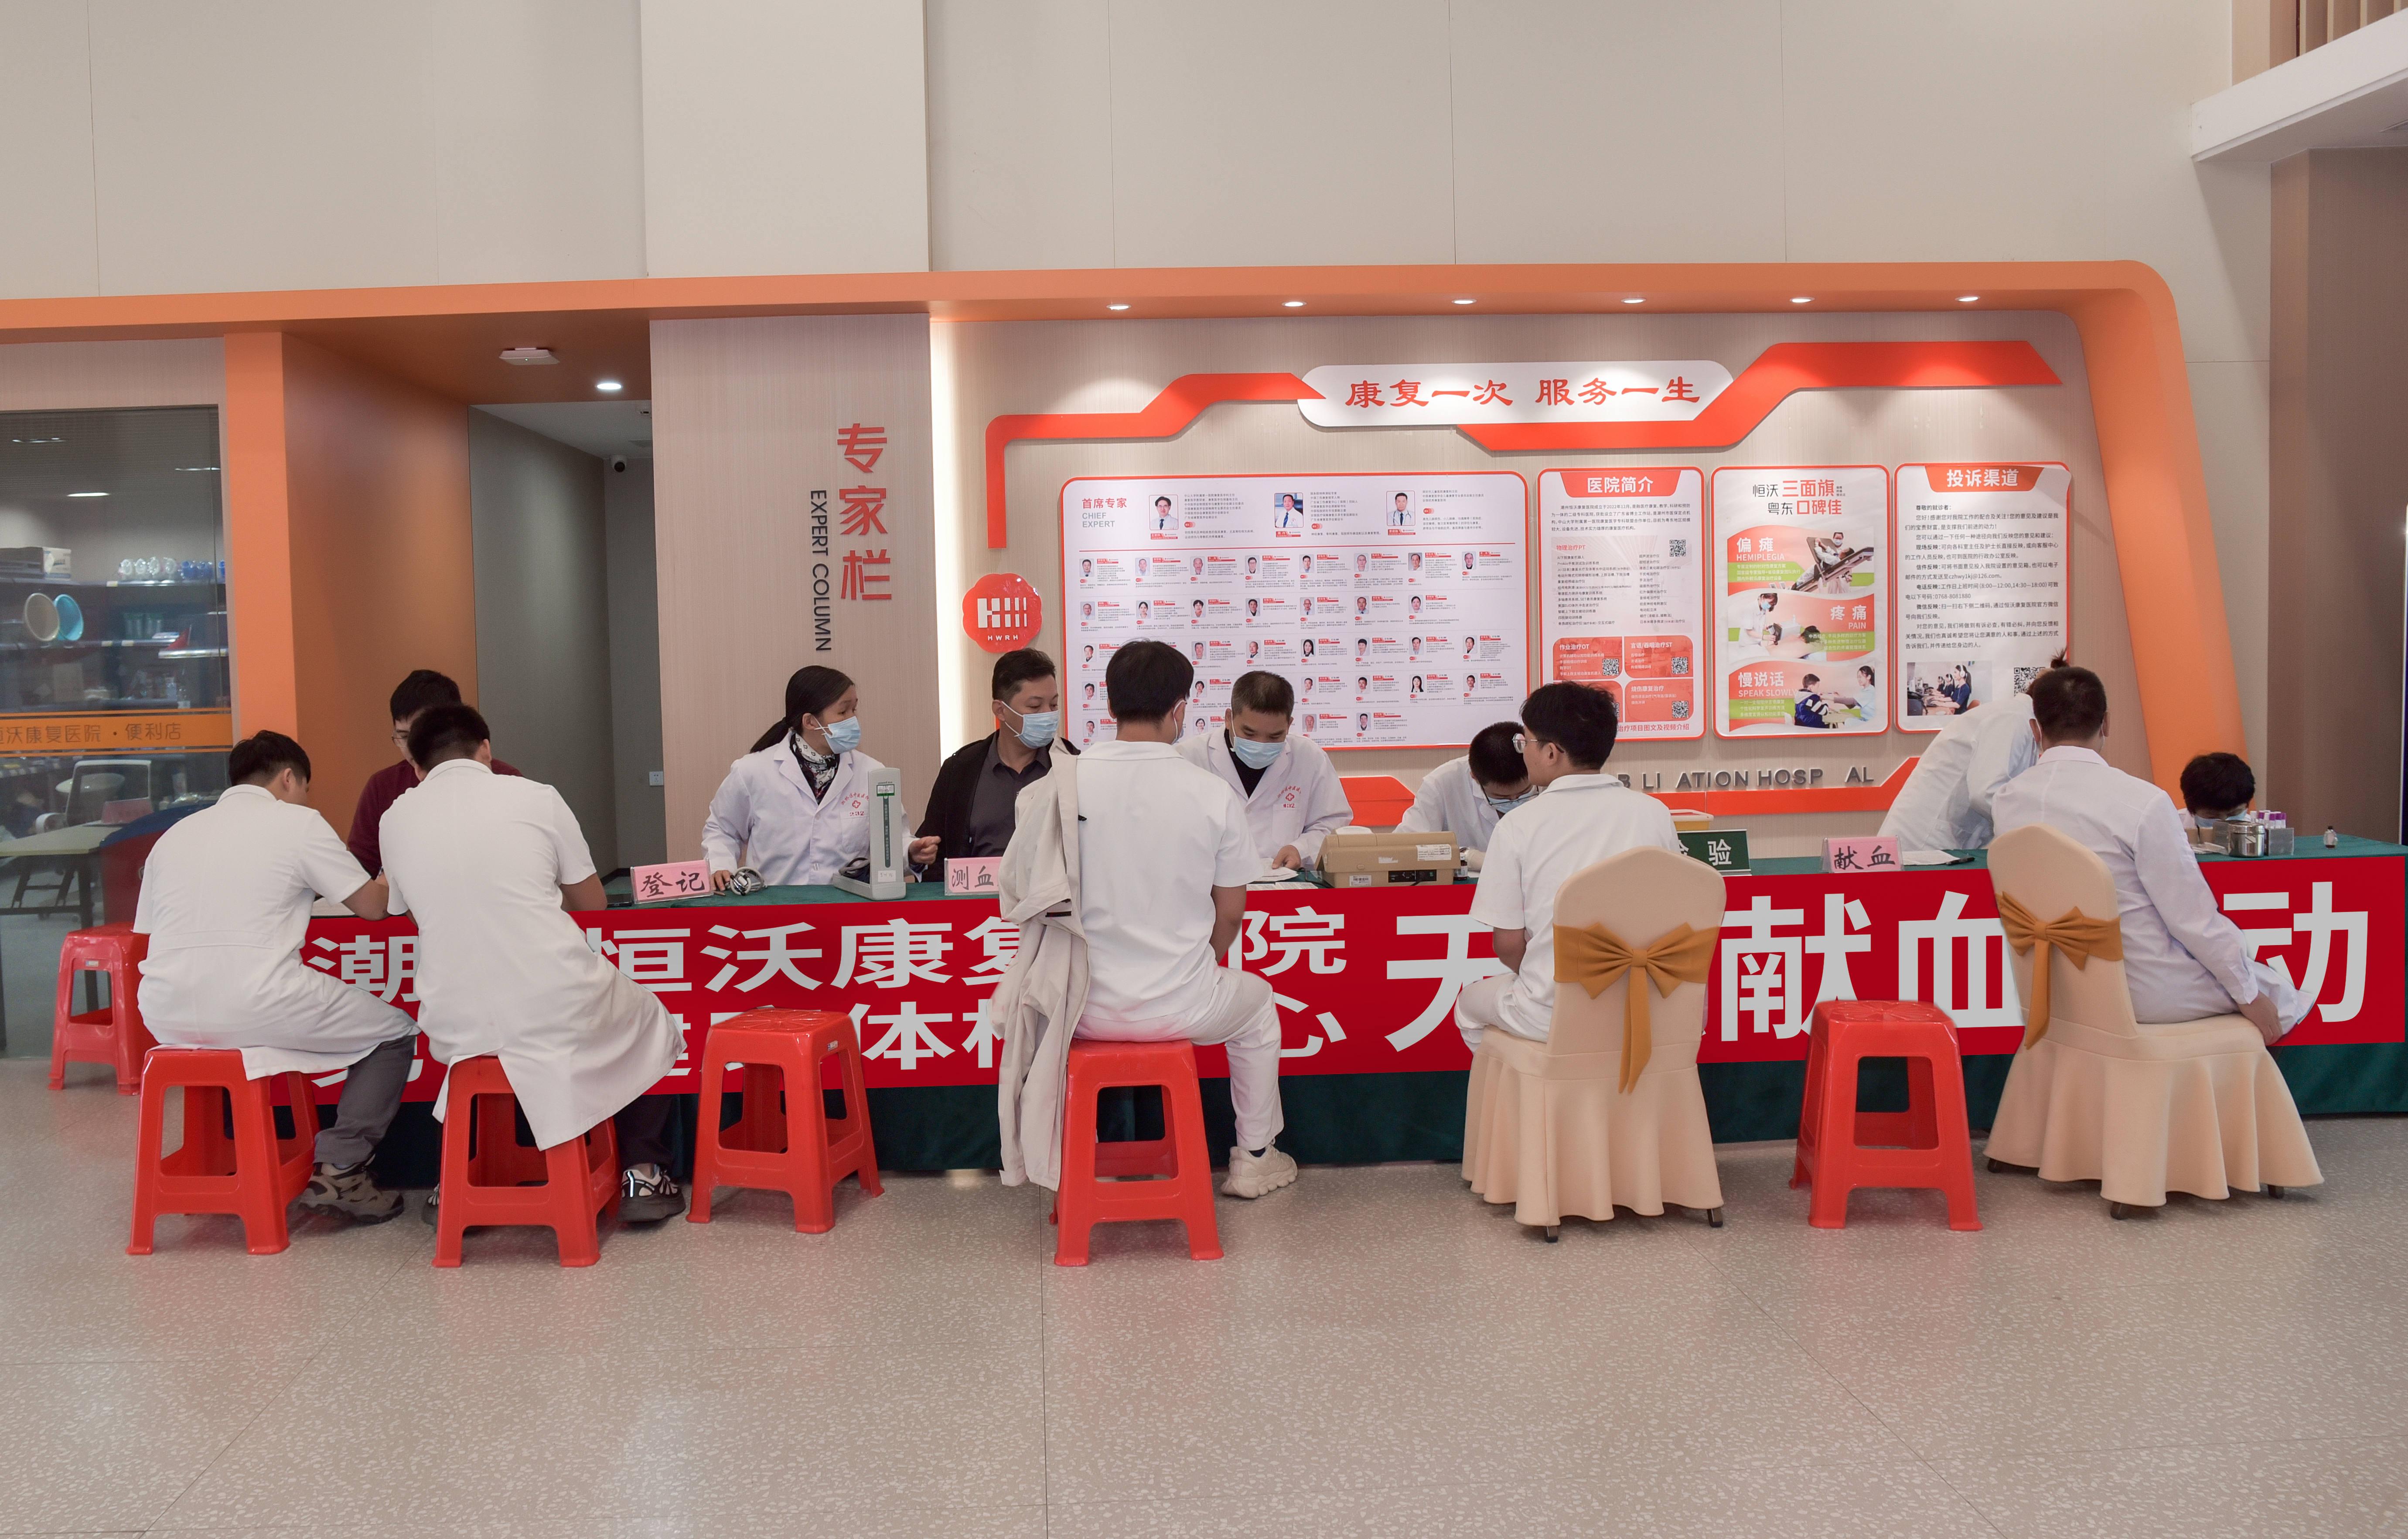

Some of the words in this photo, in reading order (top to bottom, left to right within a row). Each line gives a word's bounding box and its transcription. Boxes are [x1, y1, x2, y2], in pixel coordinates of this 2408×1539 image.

[1345, 378, 1513, 408] 康复一次
[1535, 377, 1700, 406] 服务一生
[1587, 476, 1653, 493] 医院简介
[1947, 469, 2019, 487] 投诉渠道
[1753, 484, 1778, 497] 恒沃
[1782, 479, 1834, 497] 三面旗
[837, 422, 892, 600] 专家栏
[1082, 498, 1127, 509] 首席专家
[1768, 502, 1793, 515] 粤东
[1797, 500, 1842, 514] 口碑佳
[810, 490, 829, 557] EXPERT
[1737, 537, 1774, 552] 偏瘫
[812, 563, 832, 651] COLUMN
[1831, 605, 1867, 621] 疼痛
[1738, 671, 1784, 687] 慢说话
[0, 722, 181, 744] 沃康复医院·便利店
[1617, 724, 1689, 732] 治疗项目图文及视频介绍
[1834, 845, 1895, 870] 献血
[641, 871, 705, 897] 登记
[952, 865, 999, 890] 测血
